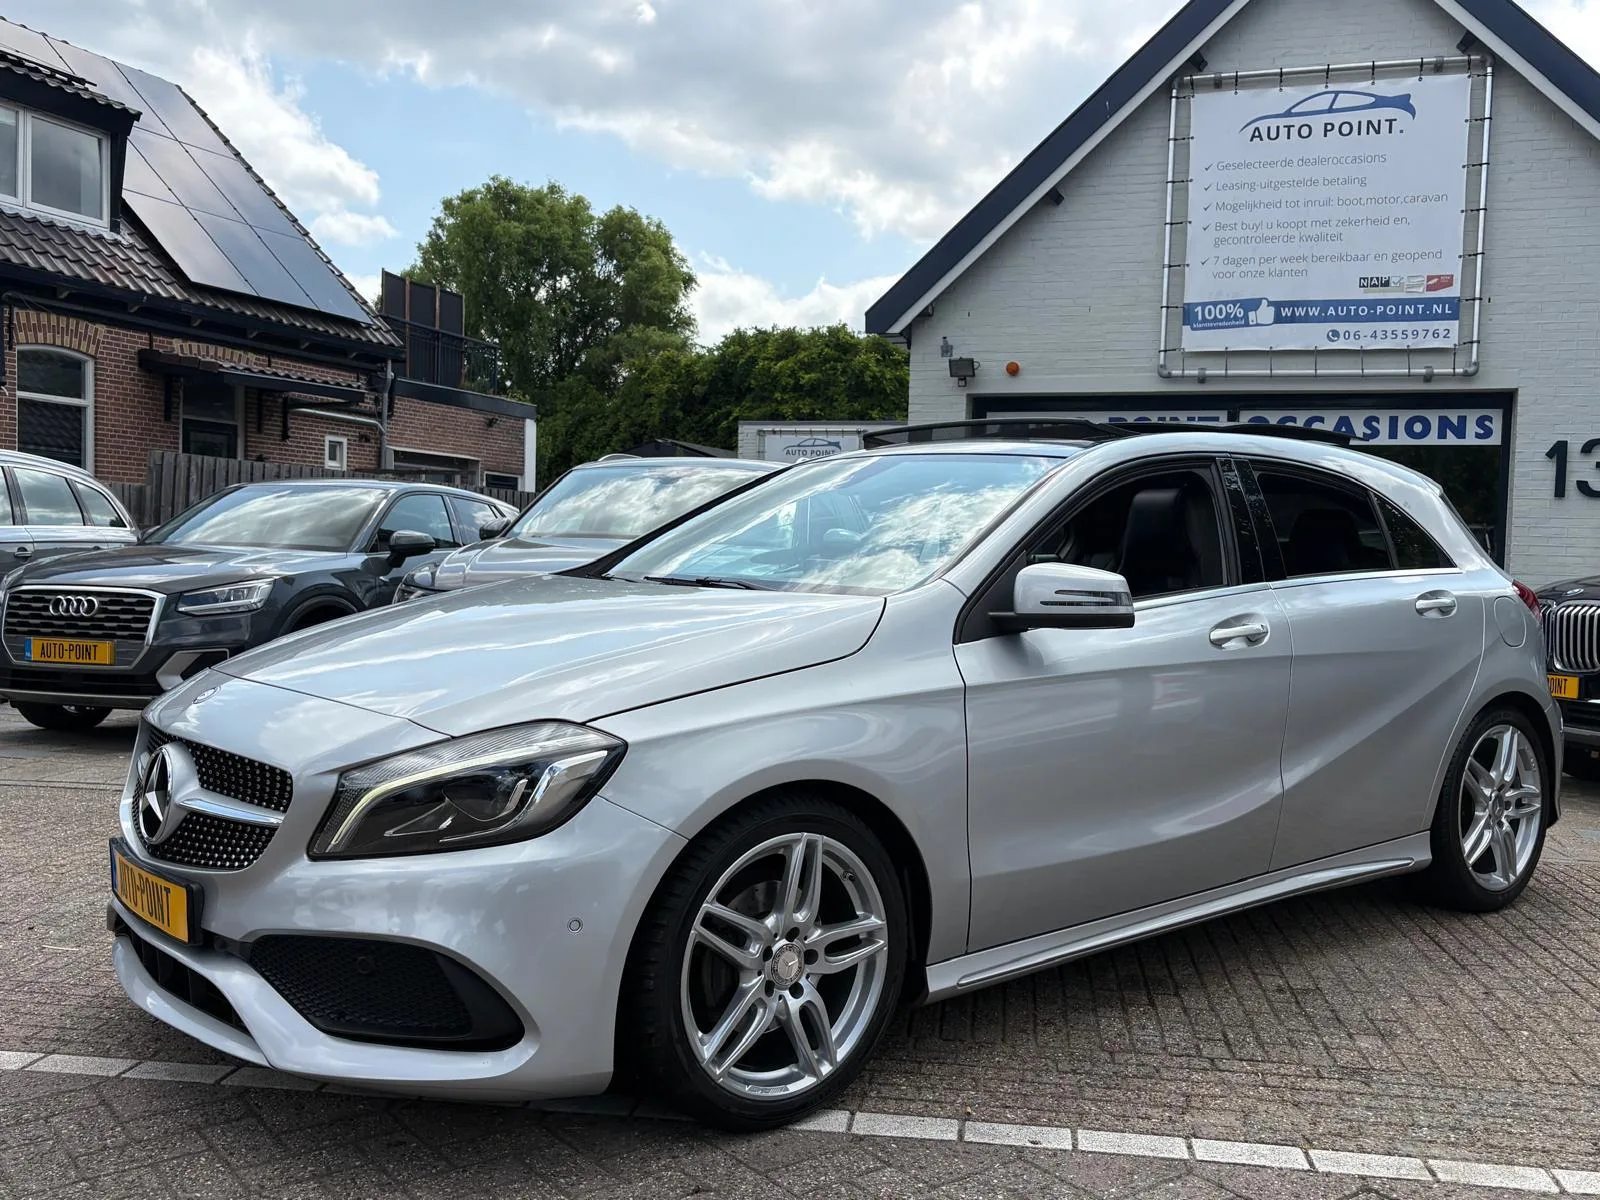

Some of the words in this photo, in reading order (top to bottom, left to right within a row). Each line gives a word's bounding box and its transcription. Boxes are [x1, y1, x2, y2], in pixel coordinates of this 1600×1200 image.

[1249, 123, 1313, 142] AUTO
[1216, 158, 1294, 171] Geselecteerde
[1297, 153, 1387, 167] dealeroccasions
[1322, 175, 1367, 187] betaling
[1215, 200, 1282, 213] Mogelijkheid
[1285, 199, 1301, 209] tot
[1303, 196, 1334, 208] inruil:
[1214, 221, 1238, 232] Best
[1240, 219, 1263, 233] buy!
[1266, 222, 1273, 231] u
[1276, 218, 1307, 231] koopt
[1310, 218, 1332, 229] met
[1335, 215, 1390, 228] zekerheid
[1393, 216, 1410, 226] en,
[1213, 232, 1296, 248] gecontroleerde
[1299, 230, 1343, 244] kwaliteit
[1213, 255, 1220, 265] 7
[1222, 254, 1256, 268] dagen
[1258, 254, 1277, 266] per
[1280, 252, 1309, 264] week
[1311, 250, 1370, 263] bereikbaar
[1373, 252, 1388, 262] en
[1391, 248, 1442, 263] geopend
[1212, 269, 1236, 279] voor
[1239, 268, 1265, 279] onze
[1268, 267, 1308, 278] klanten
[1359, 275, 1390, 288] NAP
[1194, 302, 1244, 321] 100%
[1280, 303, 1452, 317] WWW.AUTO-POINT.NL
[1343, 328, 1451, 341] 06-43559762
[1247, 415, 1494, 440] ASIONS
[40, 642, 98, 661] AUTO-POINT
[118, 857, 171, 929] AUTO-POINT
